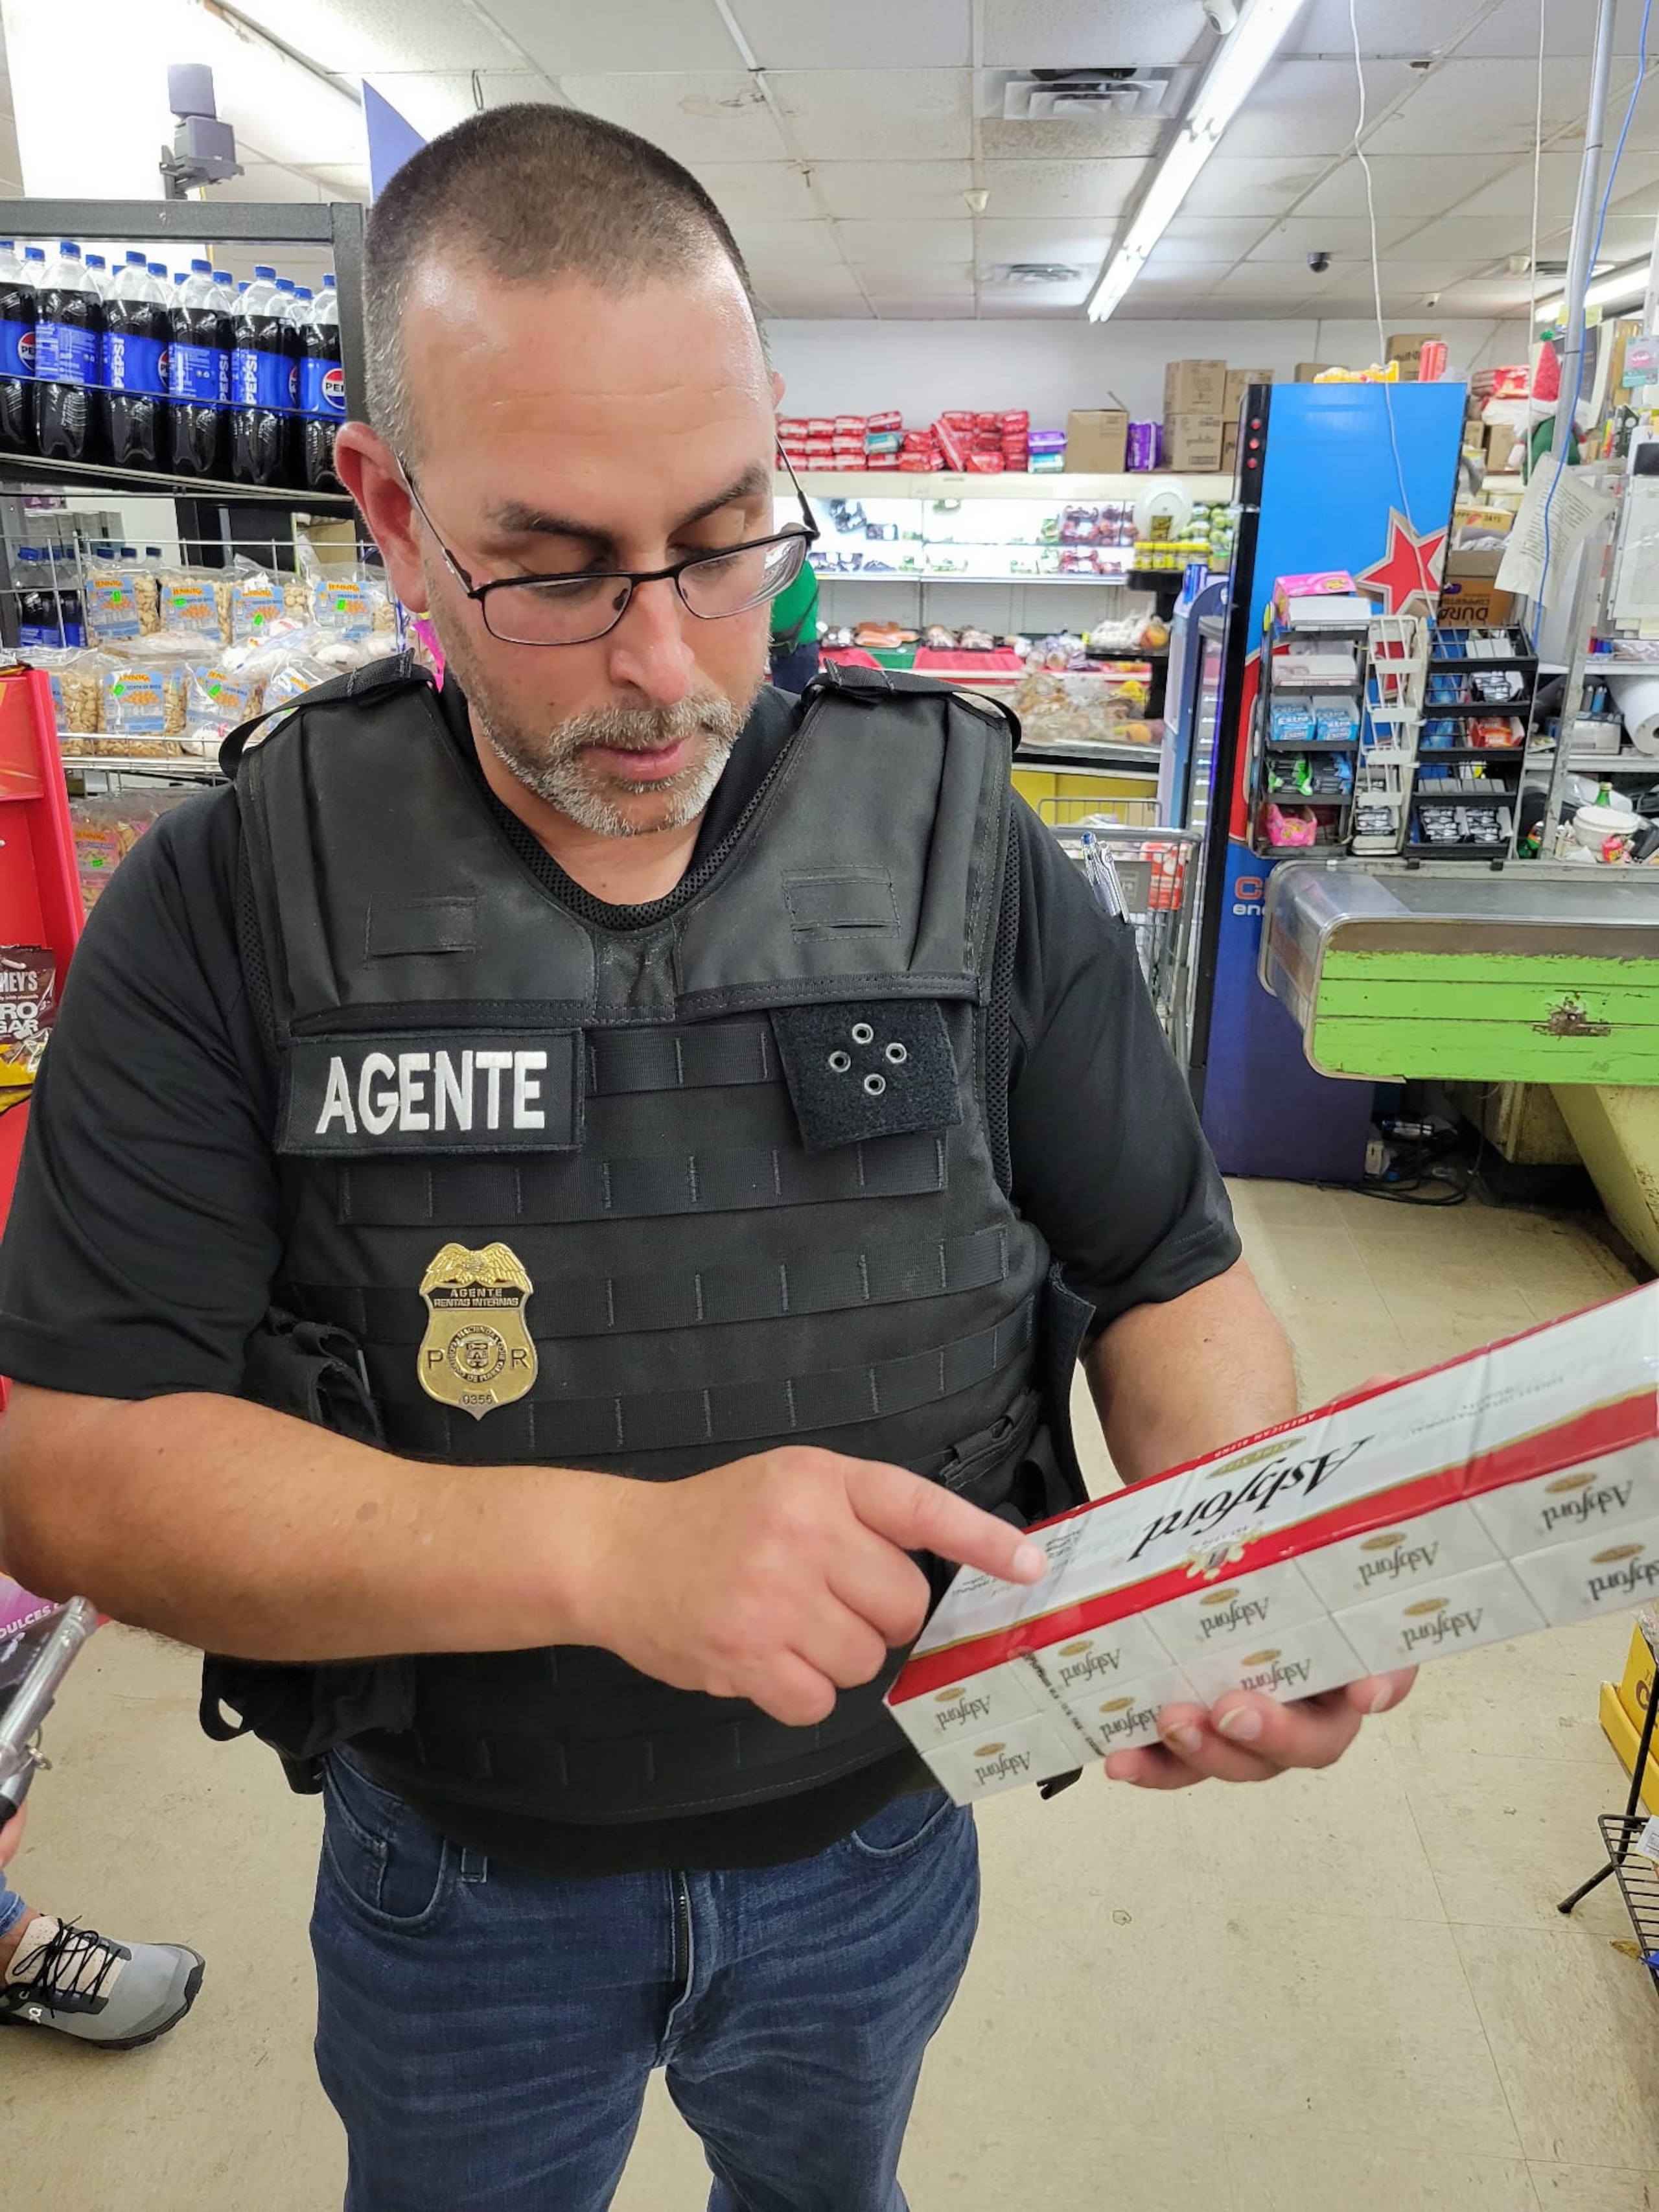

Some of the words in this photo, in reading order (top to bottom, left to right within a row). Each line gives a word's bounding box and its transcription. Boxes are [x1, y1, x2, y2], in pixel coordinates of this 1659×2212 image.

[113, 337, 125, 389] PEPSI
[219, 354, 229, 401] PEPSI
[244, 354, 258, 405] PEPSI
[315, 1050, 547, 1135] AGENTE
[433, 1298, 470, 1307] RENTAS
[471, 1298, 519, 1307] INTERNAS
[450, 1288, 502, 1298] AGENTE
[427, 1349, 444, 1369] P
[511, 1348, 531, 1369] R
[1213, 1438, 1251, 1458] BLEND
[1253, 1413, 1317, 1442] AMERICAN
[1127, 1434, 1376, 1562] Ashford
[1541, 1479, 1634, 1531] Ashford
[1358, 1540, 1440, 1586] Ashford
[1588, 1556, 1659, 1601] shford
[1200, 1597, 1270, 1638] Ashford
[1402, 1607, 1483, 1651] Ashford
[1058, 1648, 1121, 1686] Ashford
[936, 1695, 992, 1731] Ashford
[975, 1751, 1031, 1785] Ashford
